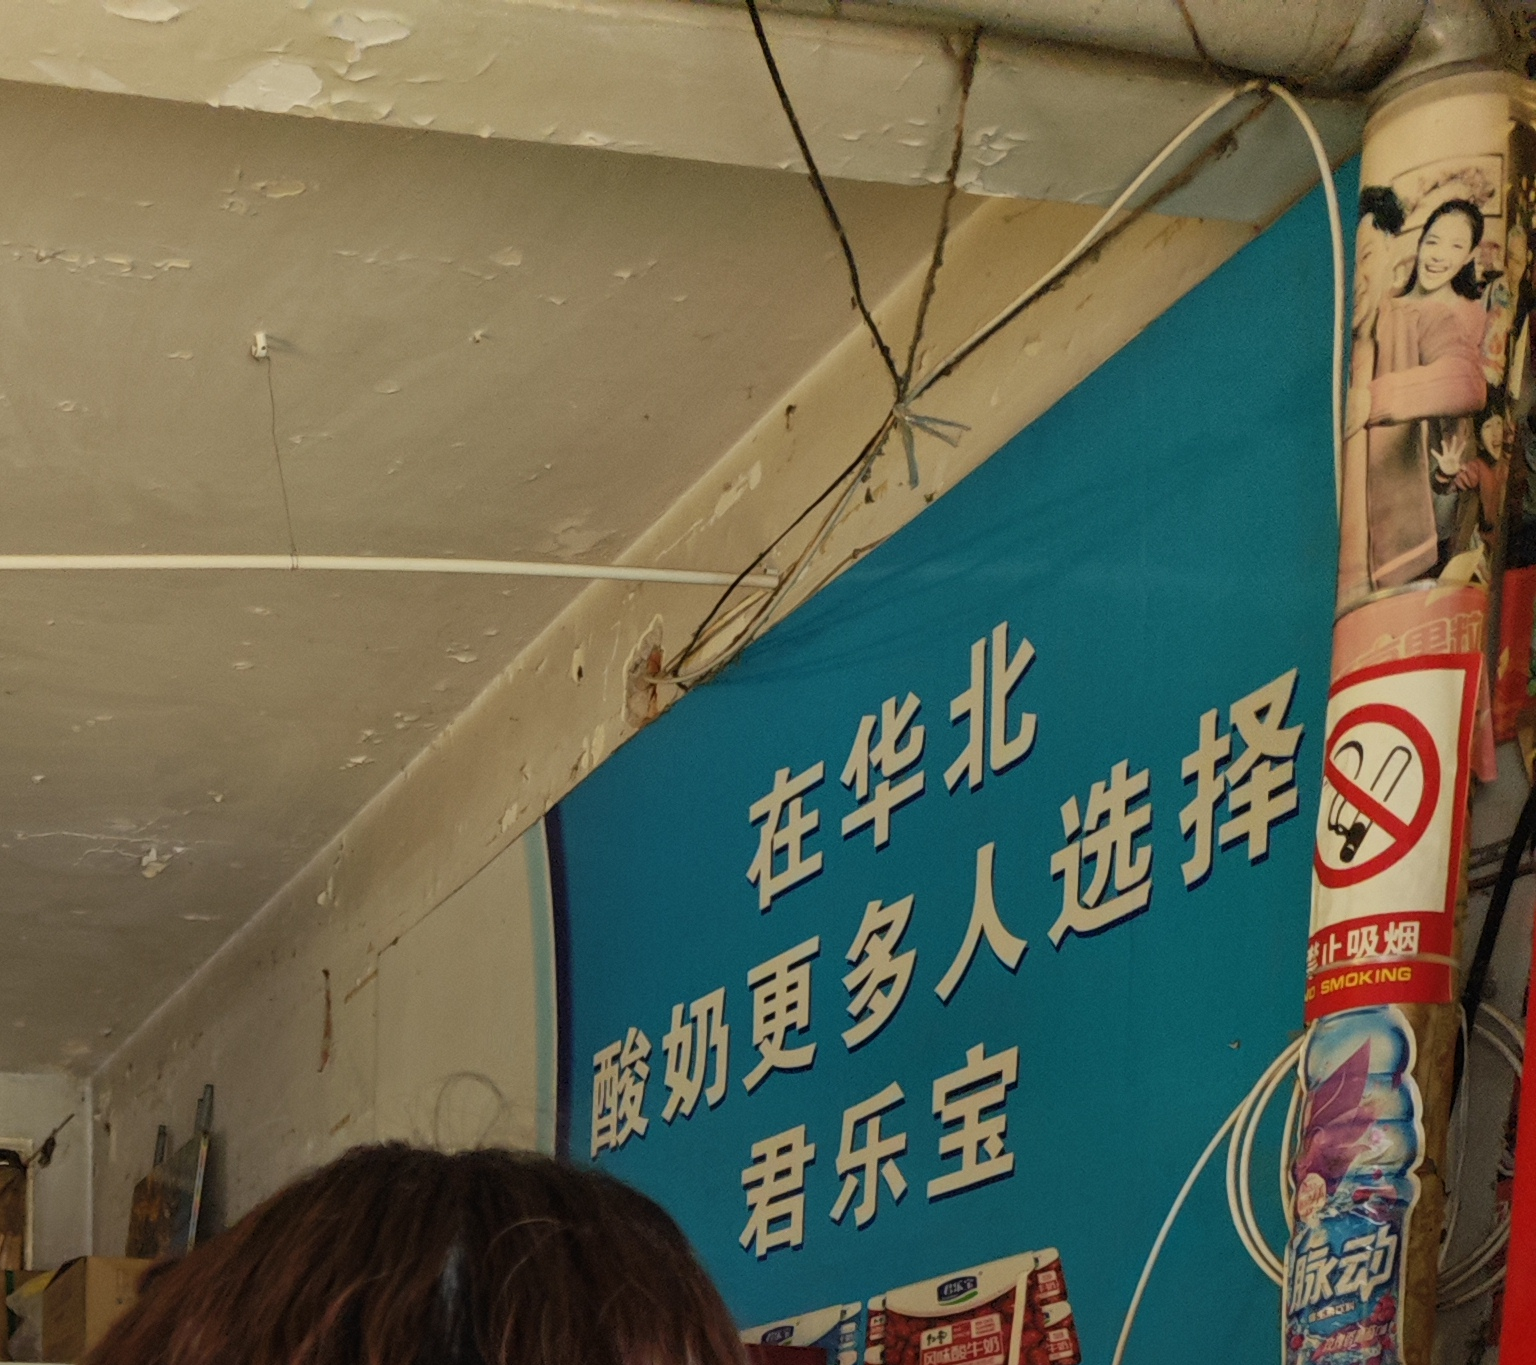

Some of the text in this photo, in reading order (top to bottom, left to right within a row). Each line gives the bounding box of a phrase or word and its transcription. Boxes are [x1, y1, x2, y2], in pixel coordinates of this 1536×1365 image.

[745, 621, 1037, 910] 在华北
[590, 667, 1304, 1159] 酸奶更多人选择
[1320, 967, 1412, 994] SMOKING
[739, 1042, 1020, 1258] 君乐宝
[1290, 1224, 1398, 1315] 脉动
